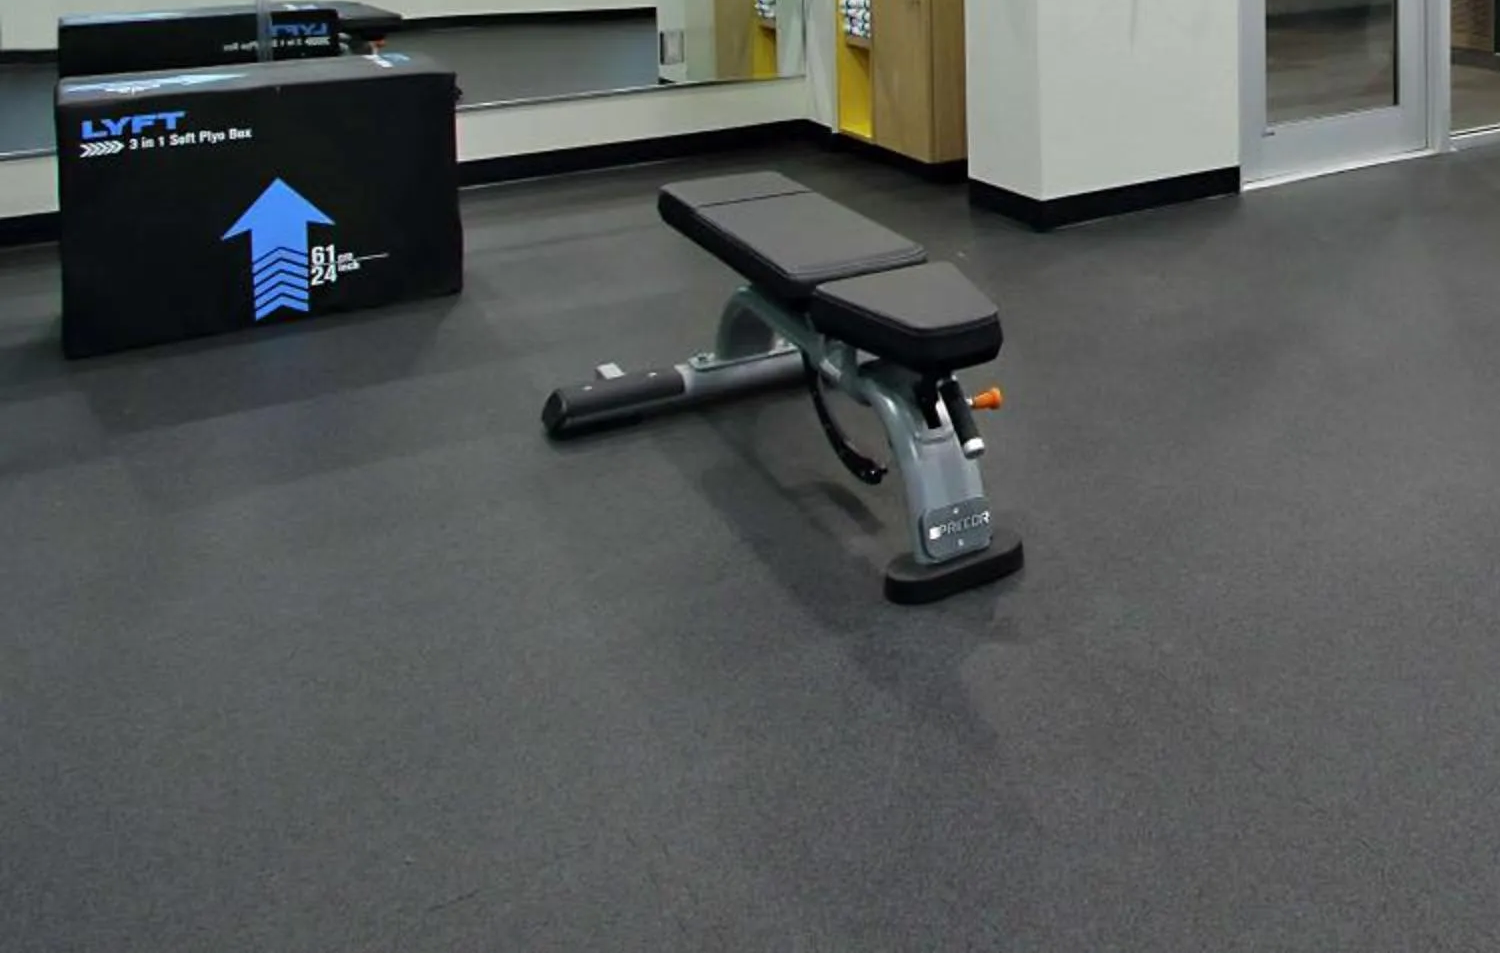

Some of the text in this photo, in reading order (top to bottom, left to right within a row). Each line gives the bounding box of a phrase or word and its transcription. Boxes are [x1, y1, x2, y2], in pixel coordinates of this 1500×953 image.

[81, 111, 186, 139] LYFT
[129, 128, 253, 151] 3 in 1 Soft Plyo Box
[311, 244, 335, 265] 61
[311, 265, 337, 286] 24
